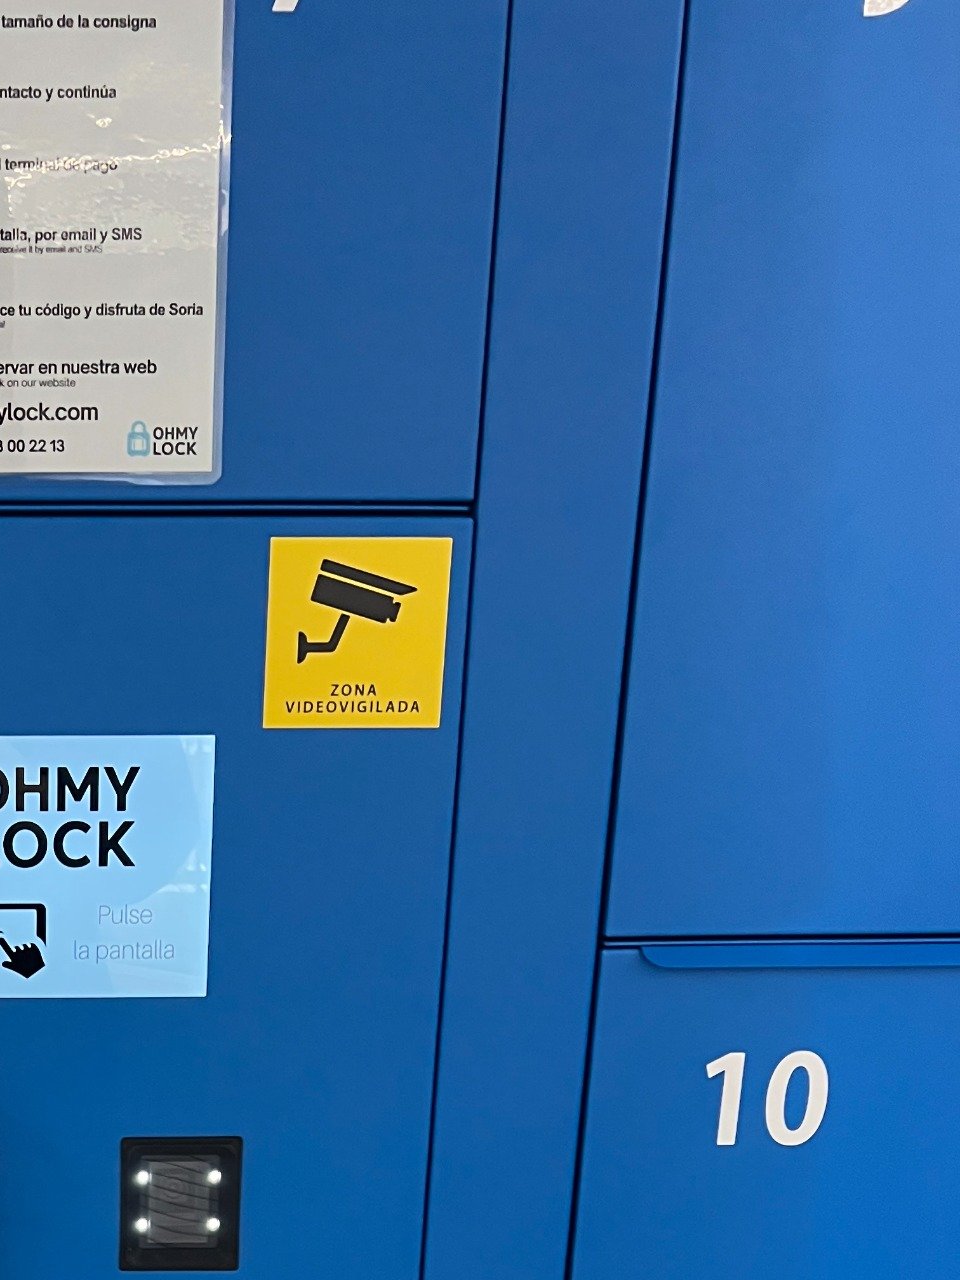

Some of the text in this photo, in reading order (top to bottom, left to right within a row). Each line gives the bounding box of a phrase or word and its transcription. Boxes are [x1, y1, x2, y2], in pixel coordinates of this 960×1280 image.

[1, 14, 53, 28] tamaño
[57, 14, 74, 28] de
[77, 14, 89, 28] la
[93, 15, 156, 31] consigna
[45, 88, 53, 102] y
[57, 85, 117, 99] continúa
[35, 231, 57, 243] por
[60, 228, 96, 241] email
[100, 231, 108, 244] y
[111, 228, 142, 241] SMS
[18, 304, 32, 316] tu
[35, 303, 81, 319] código
[84, 306, 92, 319] y
[96, 303, 146, 316] disfruta
[149, 303, 165, 316] de
[169, 303, 203, 316] Soria
[38, 363, 58, 375] en
[61, 361, 119, 374] nuestra
[123, 360, 157, 374] web
[7, 378, 19, 388] on
[21, 378, 37, 388] our
[39, 378, 76, 388] website
[152, 426, 198, 441] OHMY
[7, 440, 25, 452] 00
[29, 440, 47, 452] 22
[50, 440, 65, 452] 13
[153, 440, 197, 456] LOCK
[330, 684, 377, 696] ZONA
[285, 701, 420, 713] VIDEOVIGILADA
[97, 905, 152, 925] Pulse
[73, 940, 175, 964] la pantalla
[705, 1050, 829, 1147] 10
